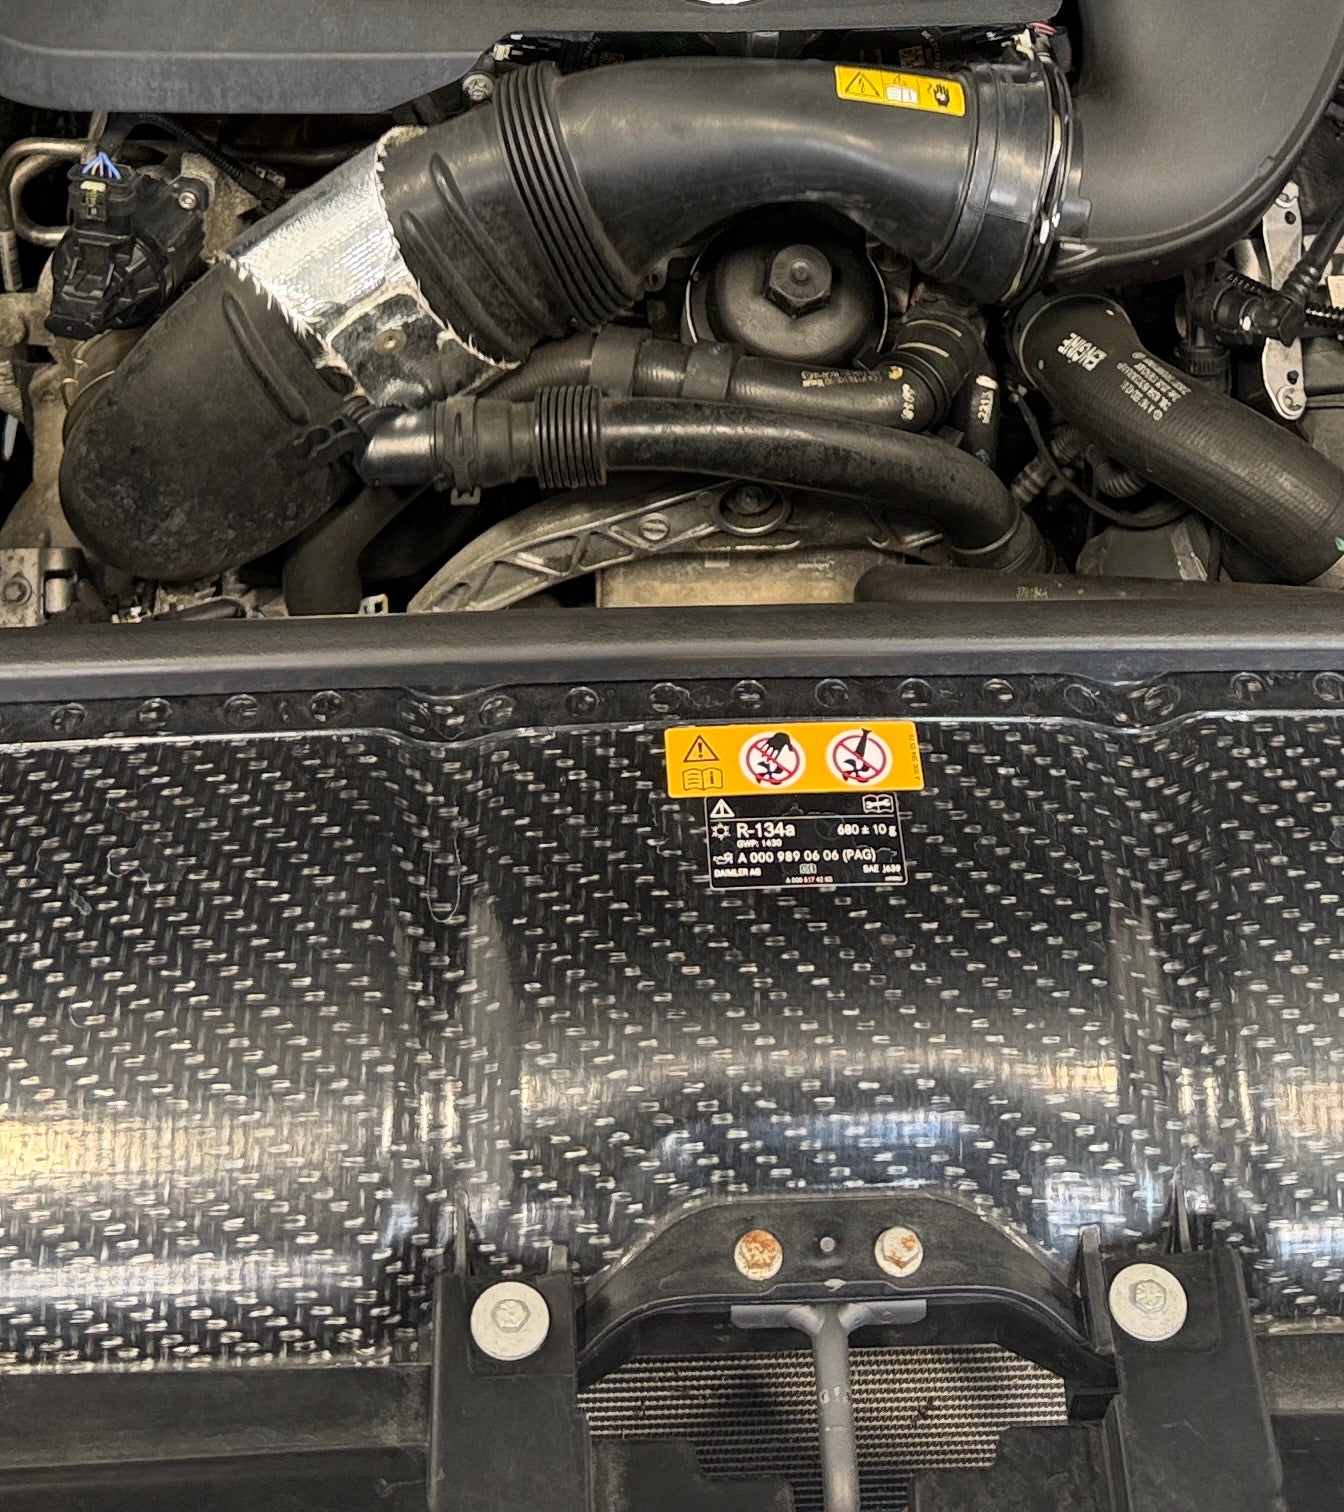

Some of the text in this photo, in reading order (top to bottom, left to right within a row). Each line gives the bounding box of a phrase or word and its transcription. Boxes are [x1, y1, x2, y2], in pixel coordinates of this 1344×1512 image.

[1057, 332, 1107, 371] ENGINE
[736, 822, 796, 838] R-134a
[837, 824, 859, 836] 680
[873, 824, 887, 834] 10
[888, 826, 897, 837] g
[762, 839, 782, 848] 1430
[737, 848, 876, 863] A 000 989 06 06 (PAG)
[714, 868, 748, 878] DAIMLER
[750, 868, 762, 876] AG
[863, 864, 879, 873] SAE
